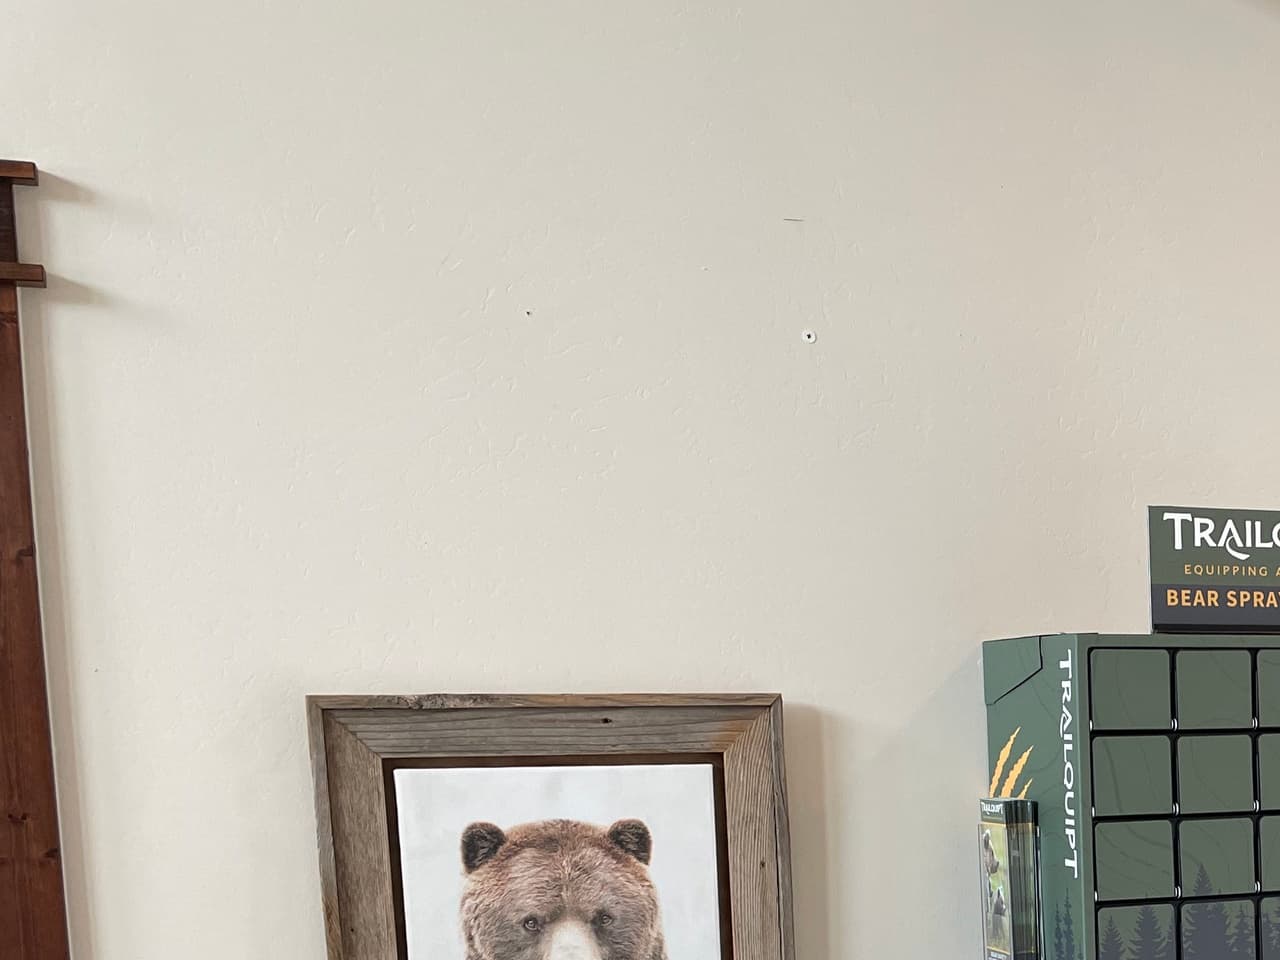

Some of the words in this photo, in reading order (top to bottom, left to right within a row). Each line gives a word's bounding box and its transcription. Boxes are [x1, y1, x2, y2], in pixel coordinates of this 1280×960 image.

[1184, 564, 1268, 577] EQUIPPING
[1166, 588, 1219, 607] BEAR
[1059, 648, 1078, 879] TRAILQUIPT
